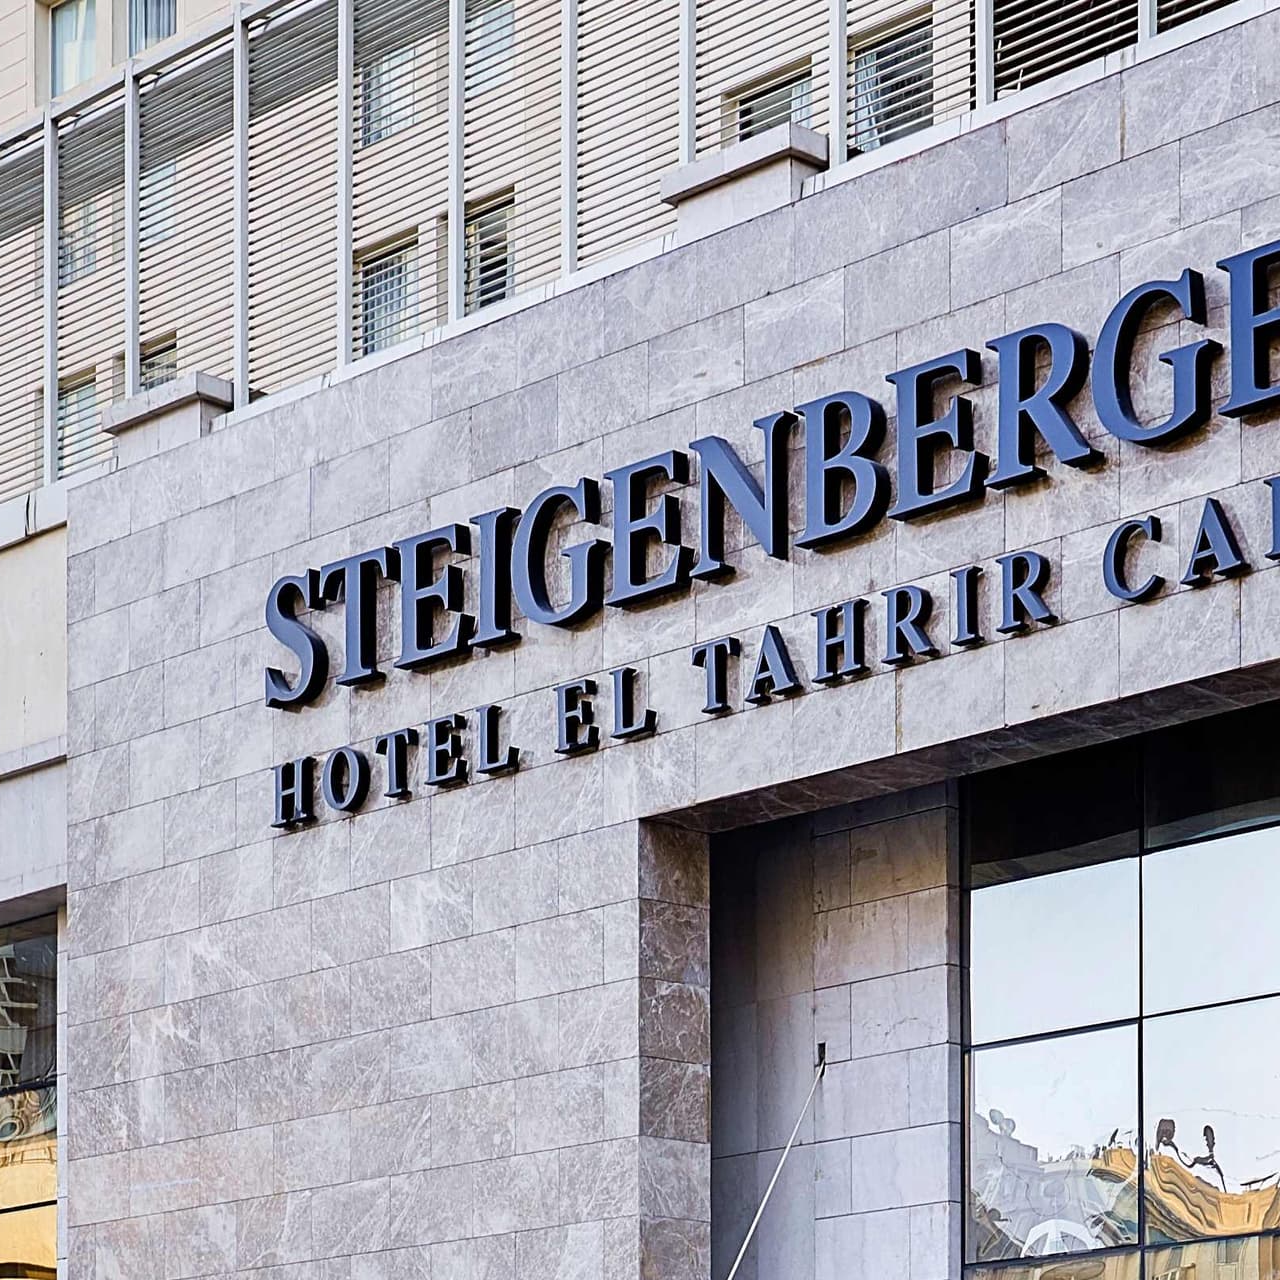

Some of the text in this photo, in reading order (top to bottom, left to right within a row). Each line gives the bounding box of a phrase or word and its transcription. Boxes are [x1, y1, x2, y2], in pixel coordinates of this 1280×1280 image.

[272, 704, 521, 831] HOTEL
[553, 666, 658, 755] EL
[691, 550, 1058, 715] TAHRIR
